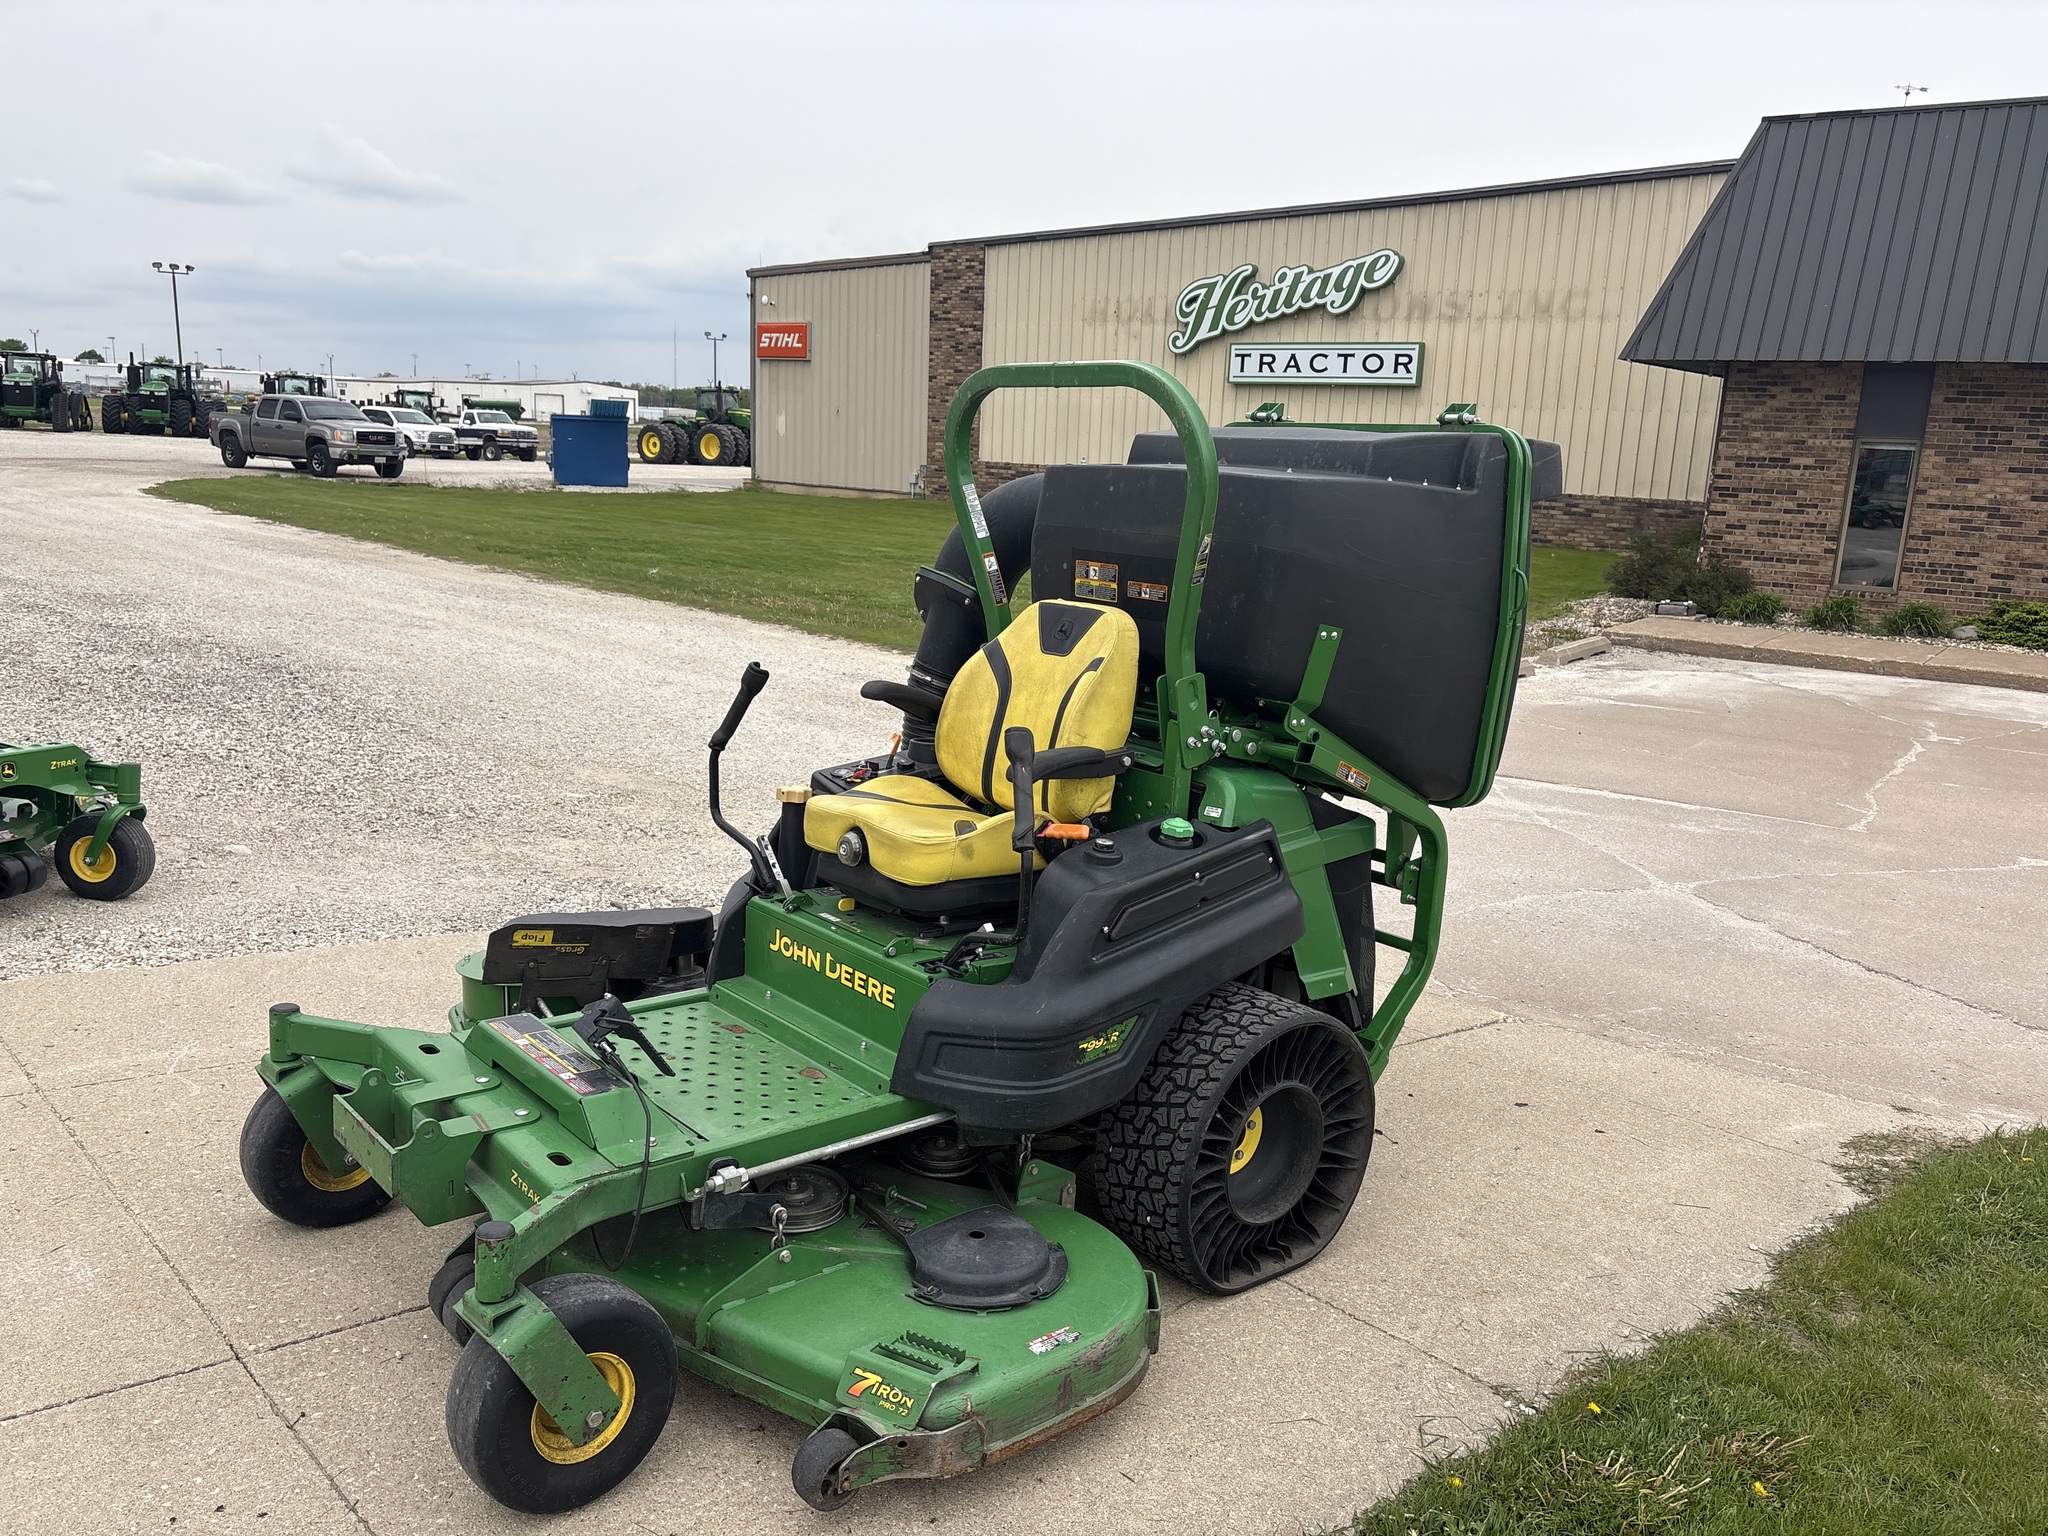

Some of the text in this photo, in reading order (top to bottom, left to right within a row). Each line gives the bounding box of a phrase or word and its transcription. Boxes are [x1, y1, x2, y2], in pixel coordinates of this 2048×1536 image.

[1169, 249, 1402, 353] Heritage
[759, 333, 803, 348] STIHL
[1235, 353, 1414, 374] TRACTOR
[50, 758, 77, 770] ZTRAK
[521, 933, 545, 943] Flap
[769, 928, 896, 1009] JOHN DEERE
[510, 1168, 541, 1204] ZTRAK
[878, 1399, 909, 1417] PRO 72
